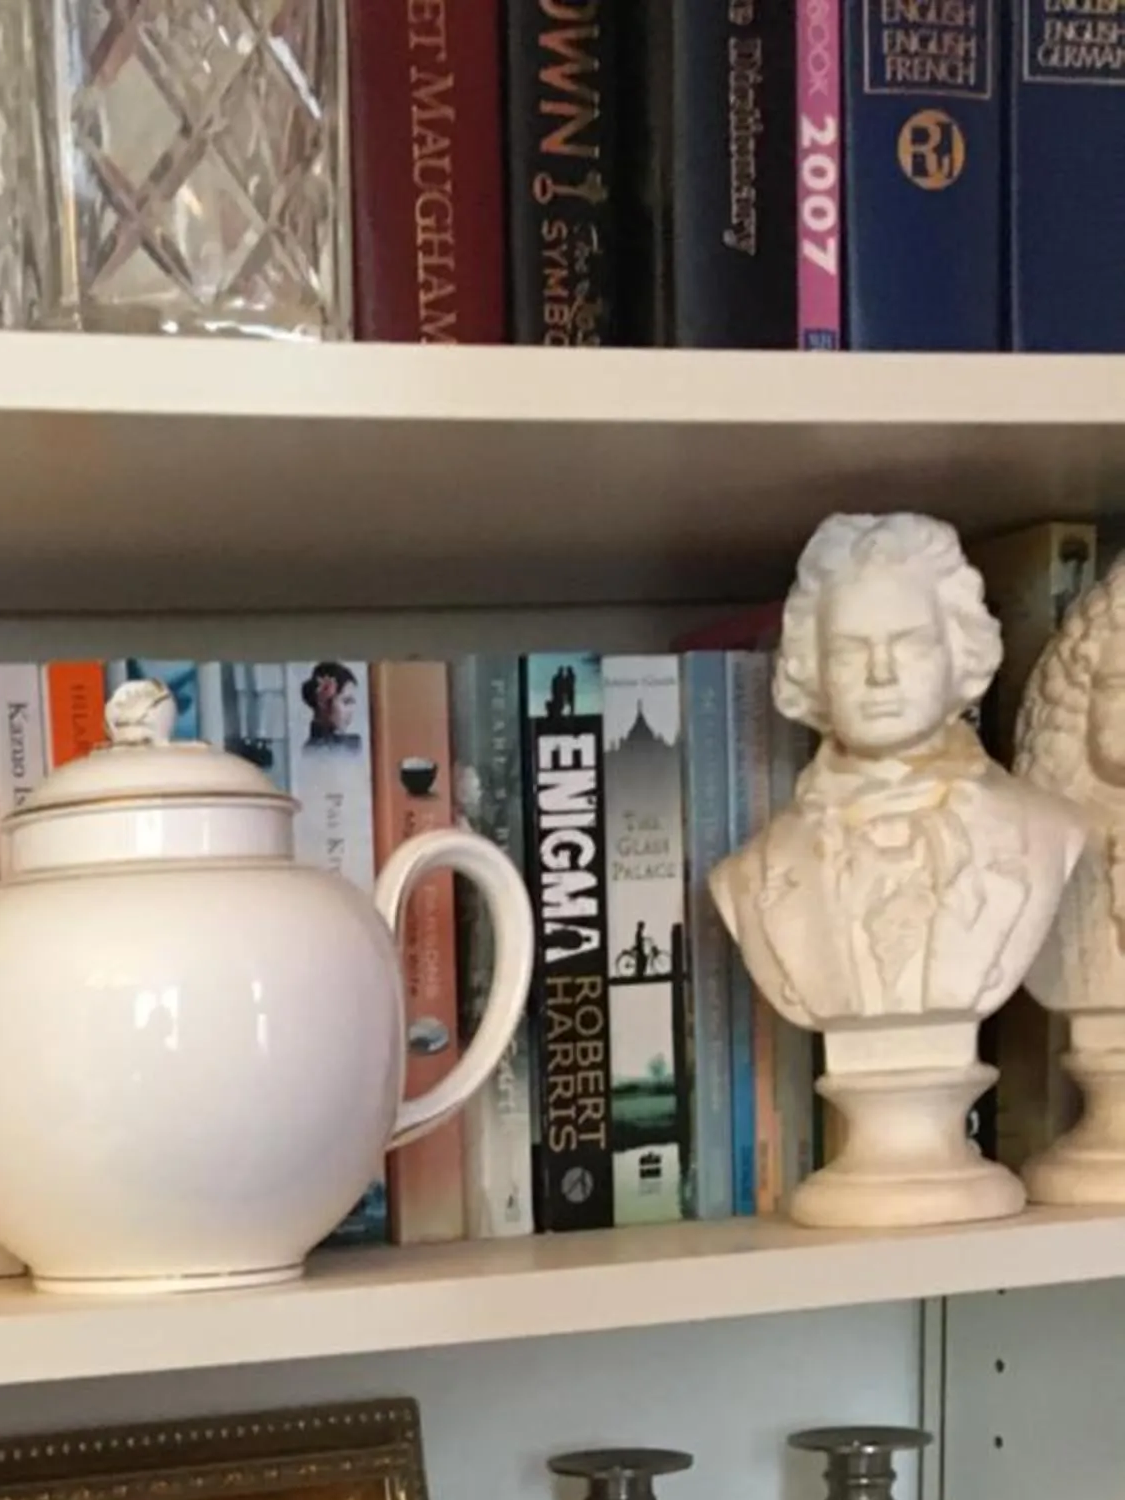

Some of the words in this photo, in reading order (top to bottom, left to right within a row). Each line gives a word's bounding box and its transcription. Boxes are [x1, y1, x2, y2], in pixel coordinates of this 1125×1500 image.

[538, 0, 601, 160] OWN
[883, 28, 978, 59] ENGLISH
[885, 55, 977, 87] FRENCH
[409, 66, 459, 344] MAUGHAM
[799, 115, 838, 277] 2007
[540, 218, 572, 346] SYMBO
[7, 702, 31, 778] Kazuo
[537, 733, 602, 963] ENIGMA
[545, 975, 577, 1152] HARRIS
[574, 974, 607, 1150] ROBERT
